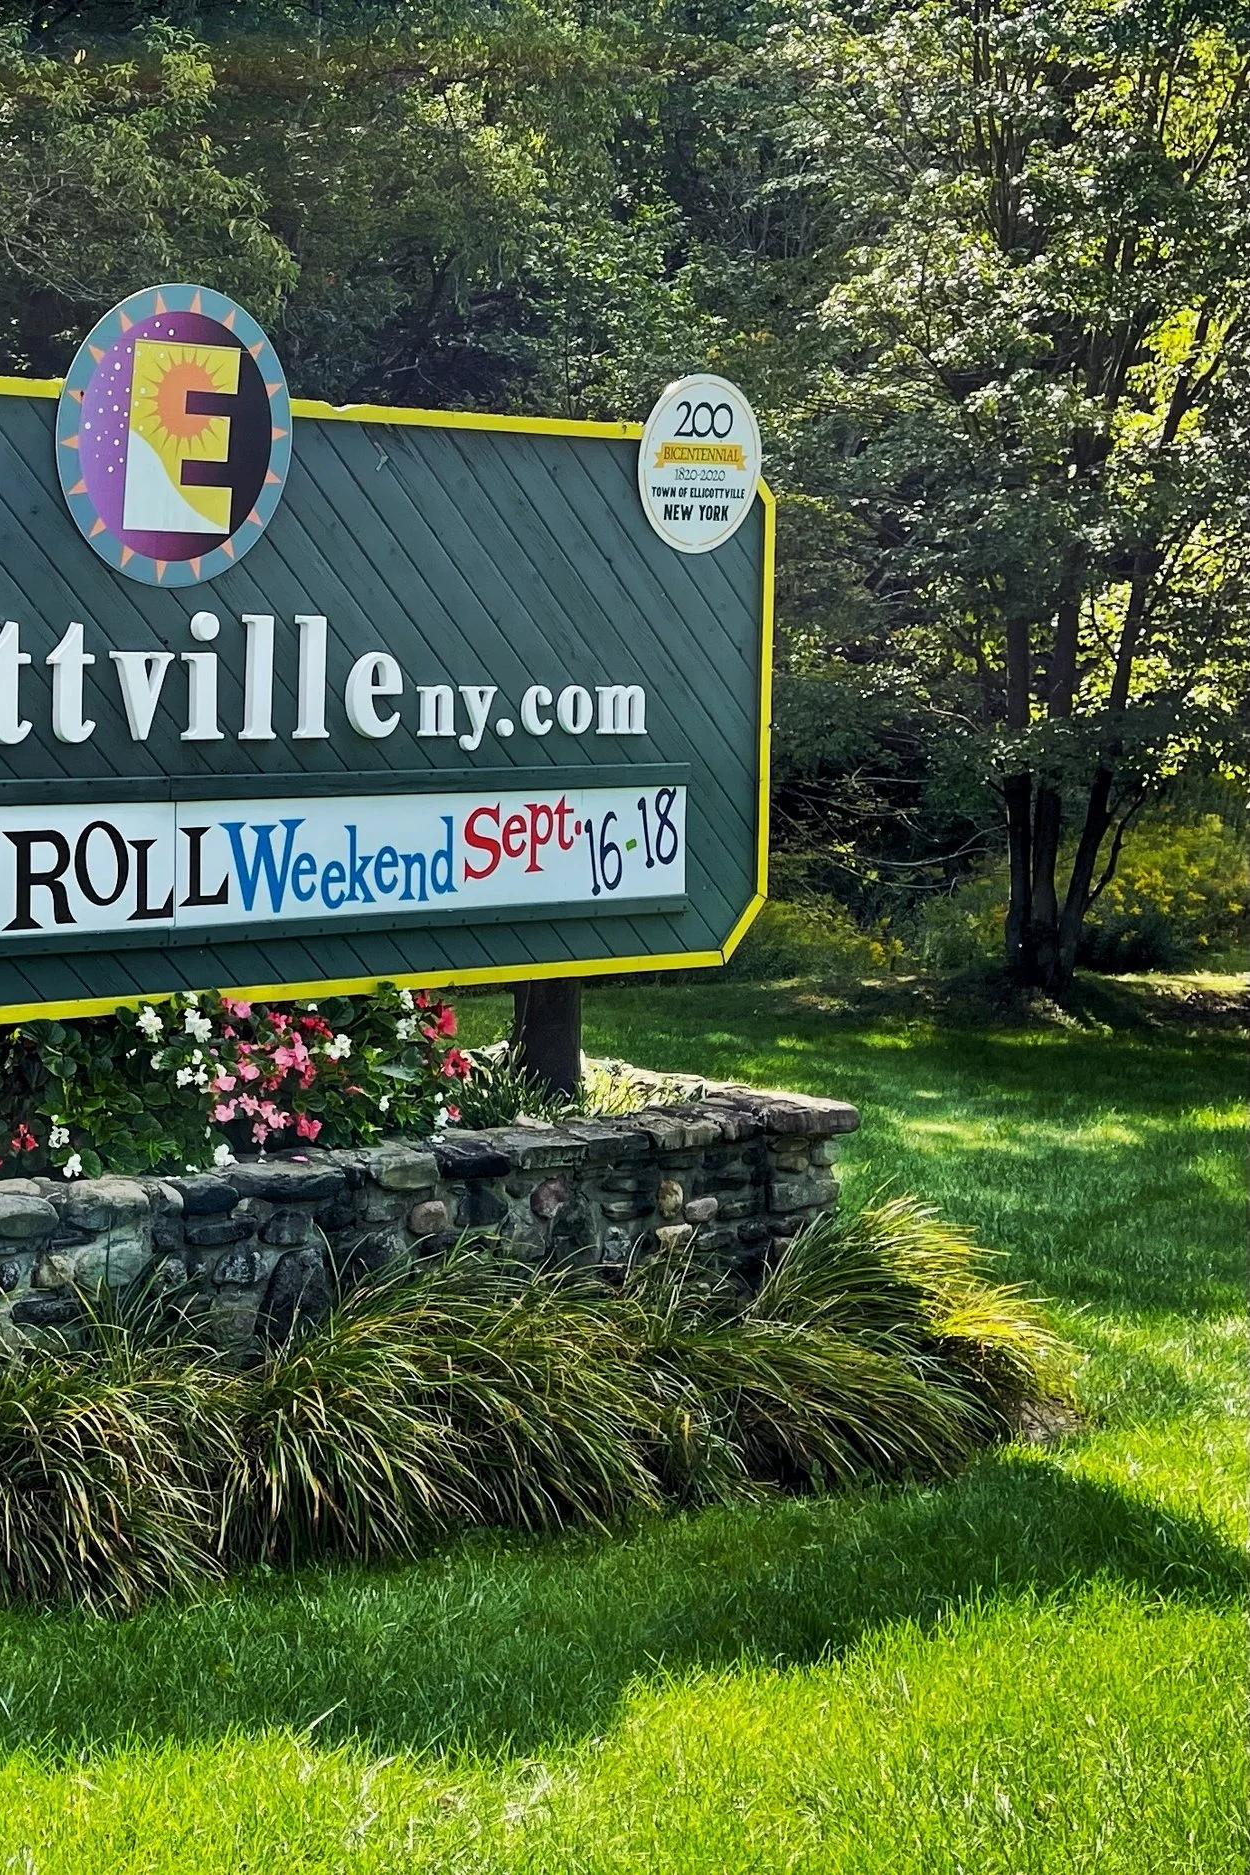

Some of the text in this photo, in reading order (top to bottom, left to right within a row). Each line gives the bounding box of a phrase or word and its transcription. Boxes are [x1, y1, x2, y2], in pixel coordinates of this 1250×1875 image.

[674, 401, 734, 439] 200
[123, 338, 241, 534] E
[663, 446, 740, 463] BICENTENNIAL
[674, 467, 726, 482] 1820-2020
[651, 486, 745, 500] TOWN OF ELLICOTTVILLE
[663, 504, 730, 521] NEW YORK
[2, 820, 229, 932] ROLL
[218, 816, 459, 914] Weekend
[463, 794, 582, 882] Sept.
[584, 786, 679, 896] 16-18
